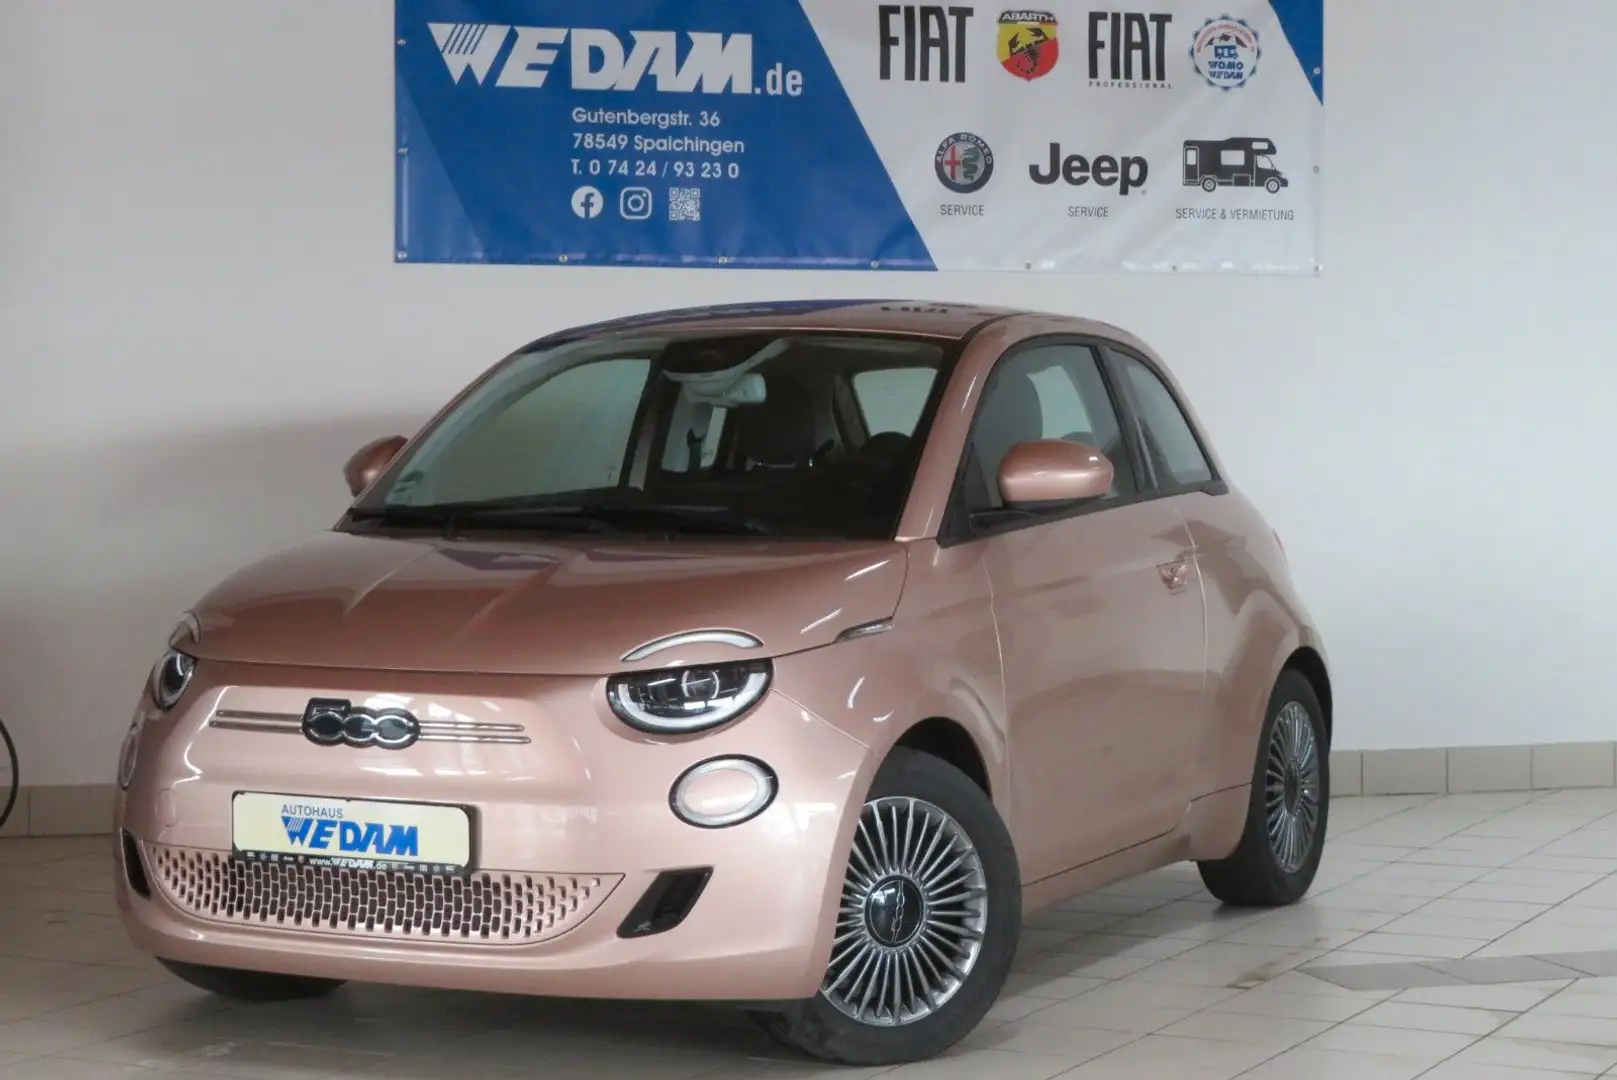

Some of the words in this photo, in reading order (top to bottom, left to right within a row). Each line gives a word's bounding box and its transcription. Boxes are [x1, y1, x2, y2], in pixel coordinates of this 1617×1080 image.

[1001, 12, 1055, 22] ABARTH
[879, 4, 975, 83] FIAT
[1088, 11, 1173, 81] FIAT
[427, 22, 803, 97] WEDAM.de
[1207, 60, 1244, 70] WOMO
[1088, 80, 1173, 89] PROFESSIONAL
[572, 107, 693, 128] Gutenbergstr.
[699, 111, 720, 127] 36
[572, 133, 628, 150] 78549
[634, 135, 745, 155] Spaichingen
[936, 138, 957, 164] ALFA
[960, 134, 993, 165] ROMEO
[571, 158, 583, 175] T.
[589, 159, 600, 175] 0
[608, 160, 629, 176] 74
[635, 160, 657, 177] 24
[662, 163, 668, 179] /
[673, 162, 695, 178] 93
[701, 162, 722, 179] 23
[728, 163, 739, 179] 0
[1029, 142, 1148, 195] Jeep
[940, 204, 985, 217] SERVICE
[1068, 206, 1109, 218] SERVICE
[1175, 207, 1217, 220] SERVICE
[1219, 208, 1228, 220] &
[1229, 208, 1294, 221] VERMIETUNG
[302, 697, 420, 750] 500
[281, 803, 344, 819] AUTOHAUS
[281, 816, 419, 857] WEDAM
[309, 856, 388, 872] www.WEDAM.de
